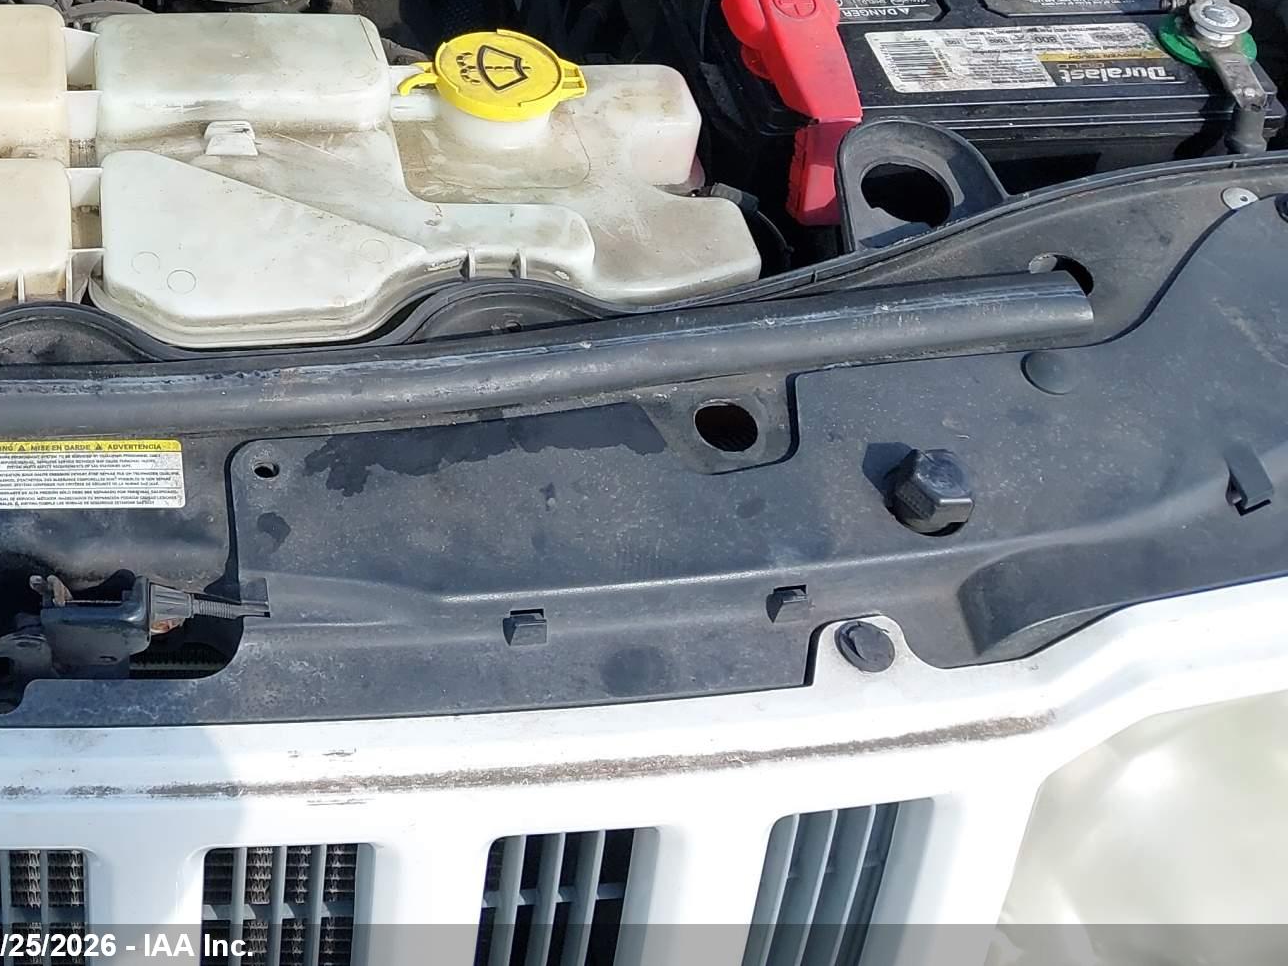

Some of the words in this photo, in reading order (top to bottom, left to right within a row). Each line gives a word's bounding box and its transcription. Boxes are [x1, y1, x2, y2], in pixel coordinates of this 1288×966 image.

[841, 7, 898, 17] DANGER
[1034, 36, 1058, 44] 800
[1102, 52, 1143, 60] PROVEN
[1056, 62, 1106, 70] GOLD
[1058, 66, 1176, 83] Duralast
